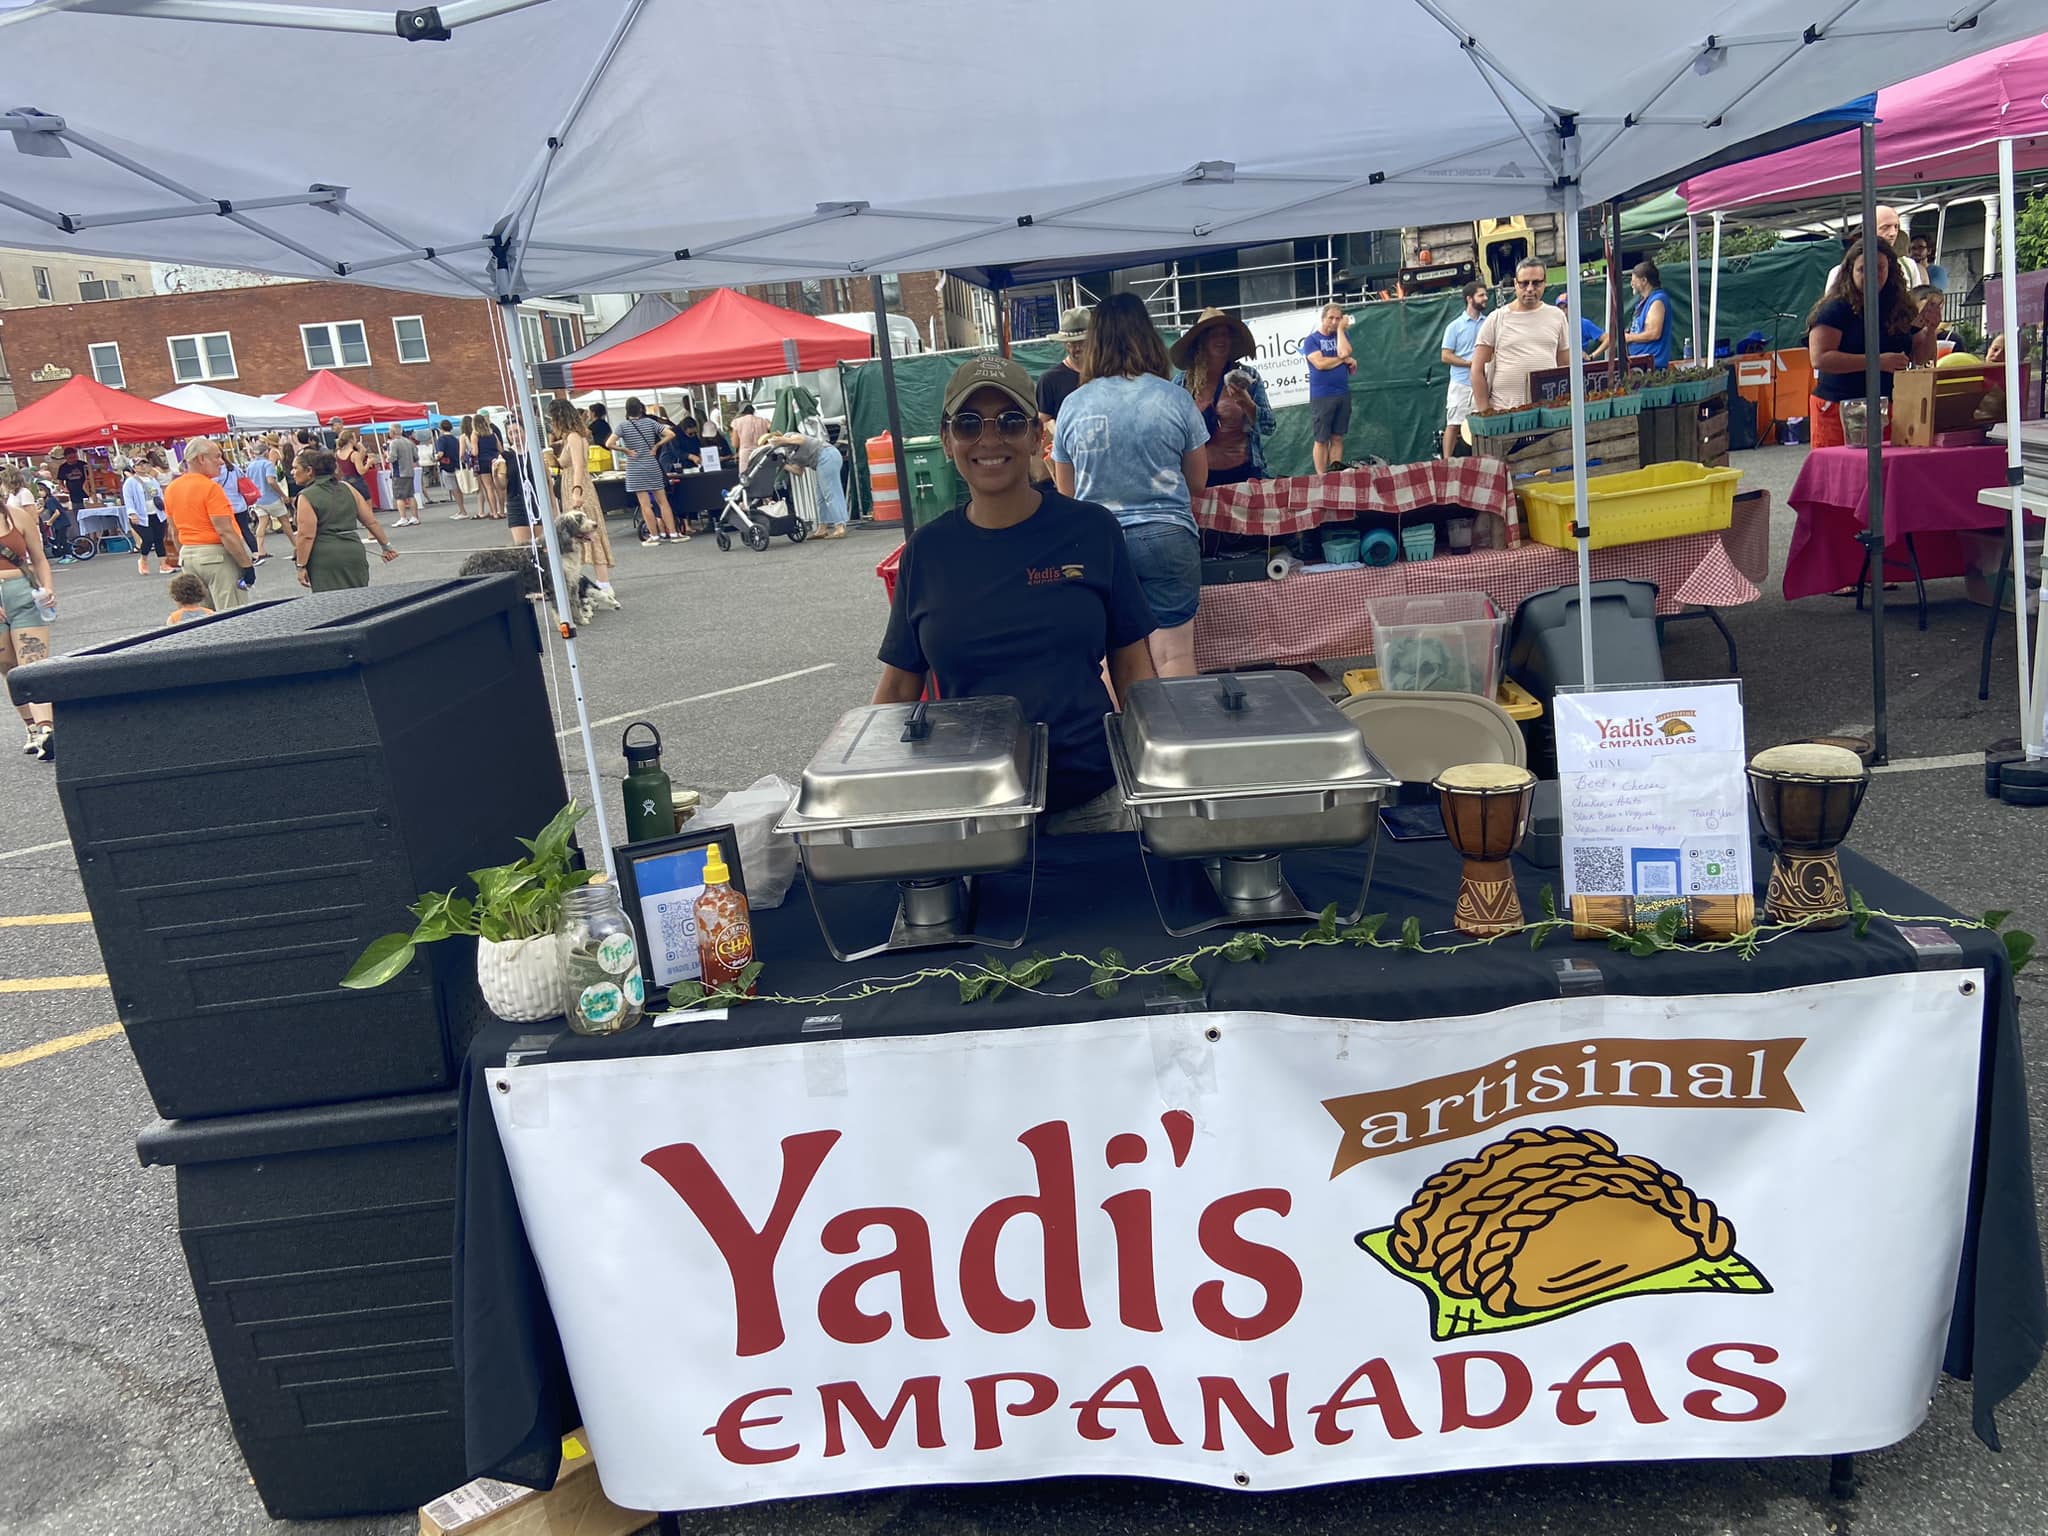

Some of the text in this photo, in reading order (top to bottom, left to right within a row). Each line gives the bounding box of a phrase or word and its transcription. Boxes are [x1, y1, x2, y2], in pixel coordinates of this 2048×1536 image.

[1595, 716, 1654, 740] Yadi's
[1599, 735, 1697, 749] EMPANADAS
[1586, 759, 1624, 769] MENU
[1688, 807, 1715, 817] Thank
[1360, 1044, 1768, 1148] artisinal
[642, 1112, 1303, 1357] Yadi's
[704, 1343, 1787, 1466] EMPANADAS
